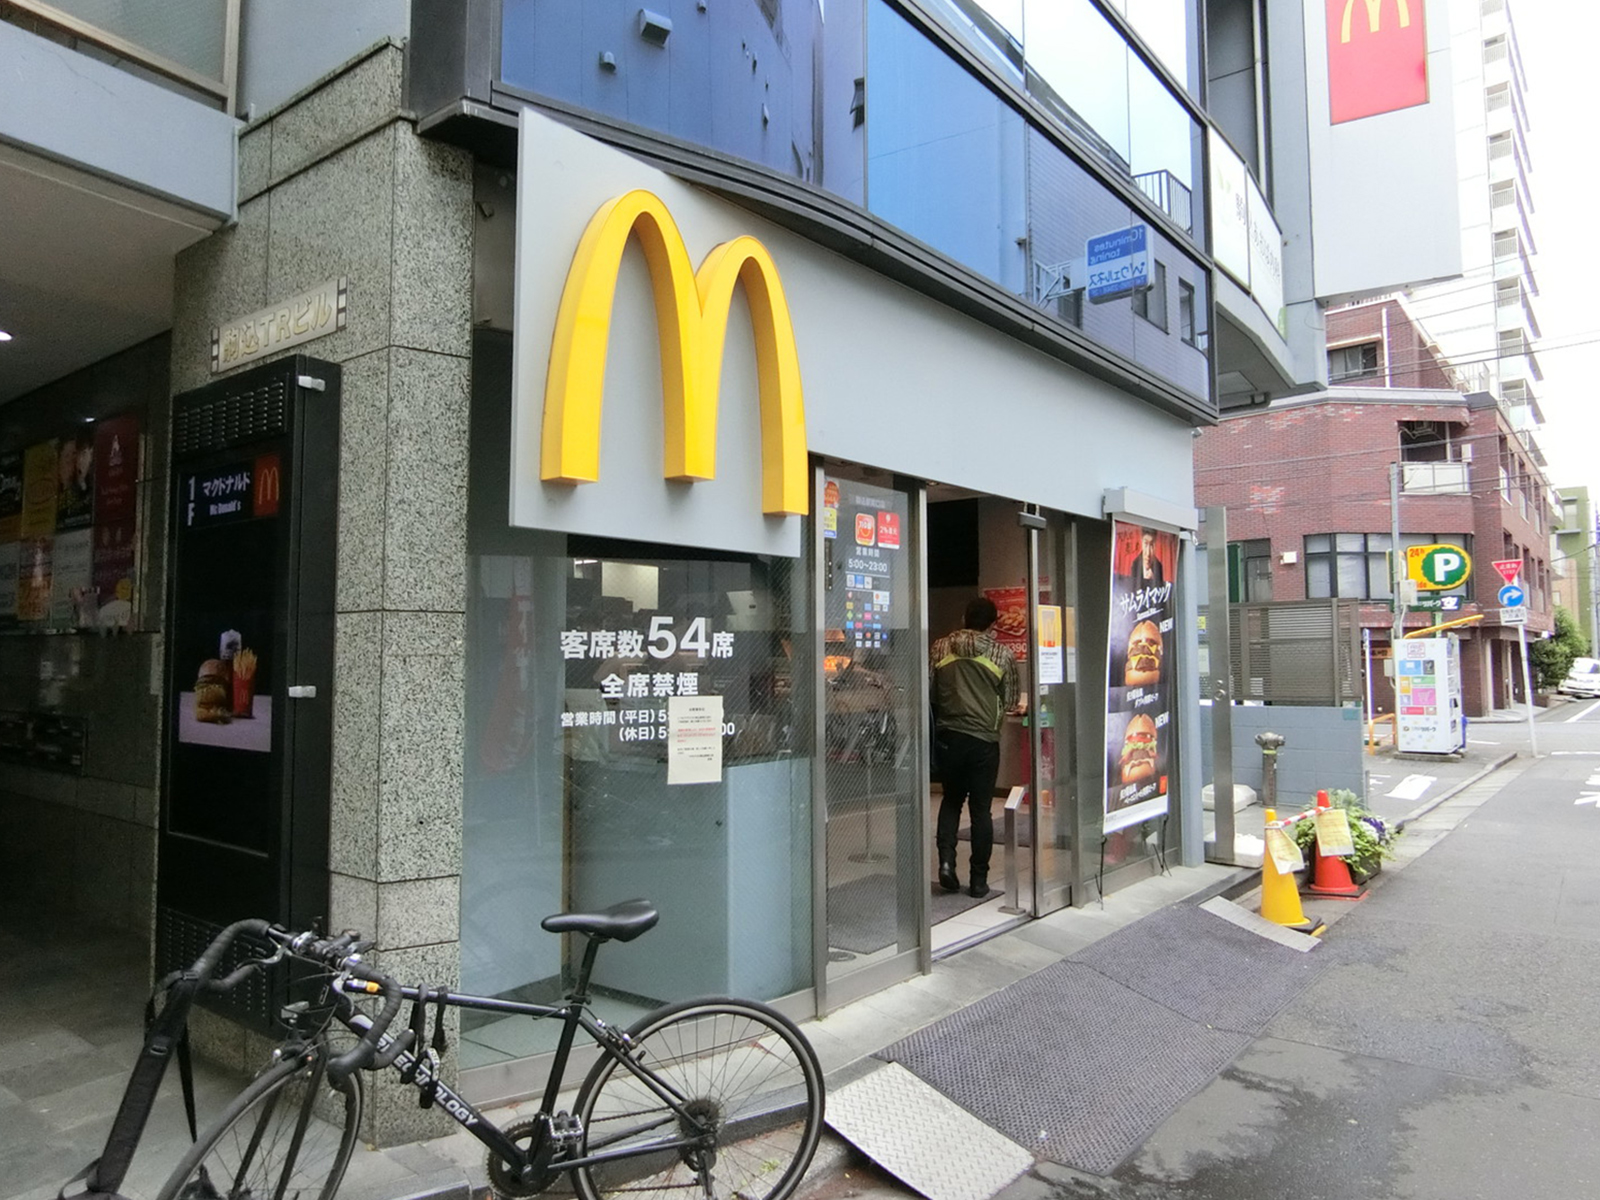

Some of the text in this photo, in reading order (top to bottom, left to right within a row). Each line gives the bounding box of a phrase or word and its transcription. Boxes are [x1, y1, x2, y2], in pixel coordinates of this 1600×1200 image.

[222, 292, 333, 364] 駒込TRビル
[202, 471, 252, 498] マクドナルド
[1433, 552, 1462, 582] P
[1119, 580, 1173, 618] サムライマック
[560, 615, 735, 660] 客席数54席
[601, 672, 699, 699] 全席禁煙
[1155, 711, 1170, 730] NEW
